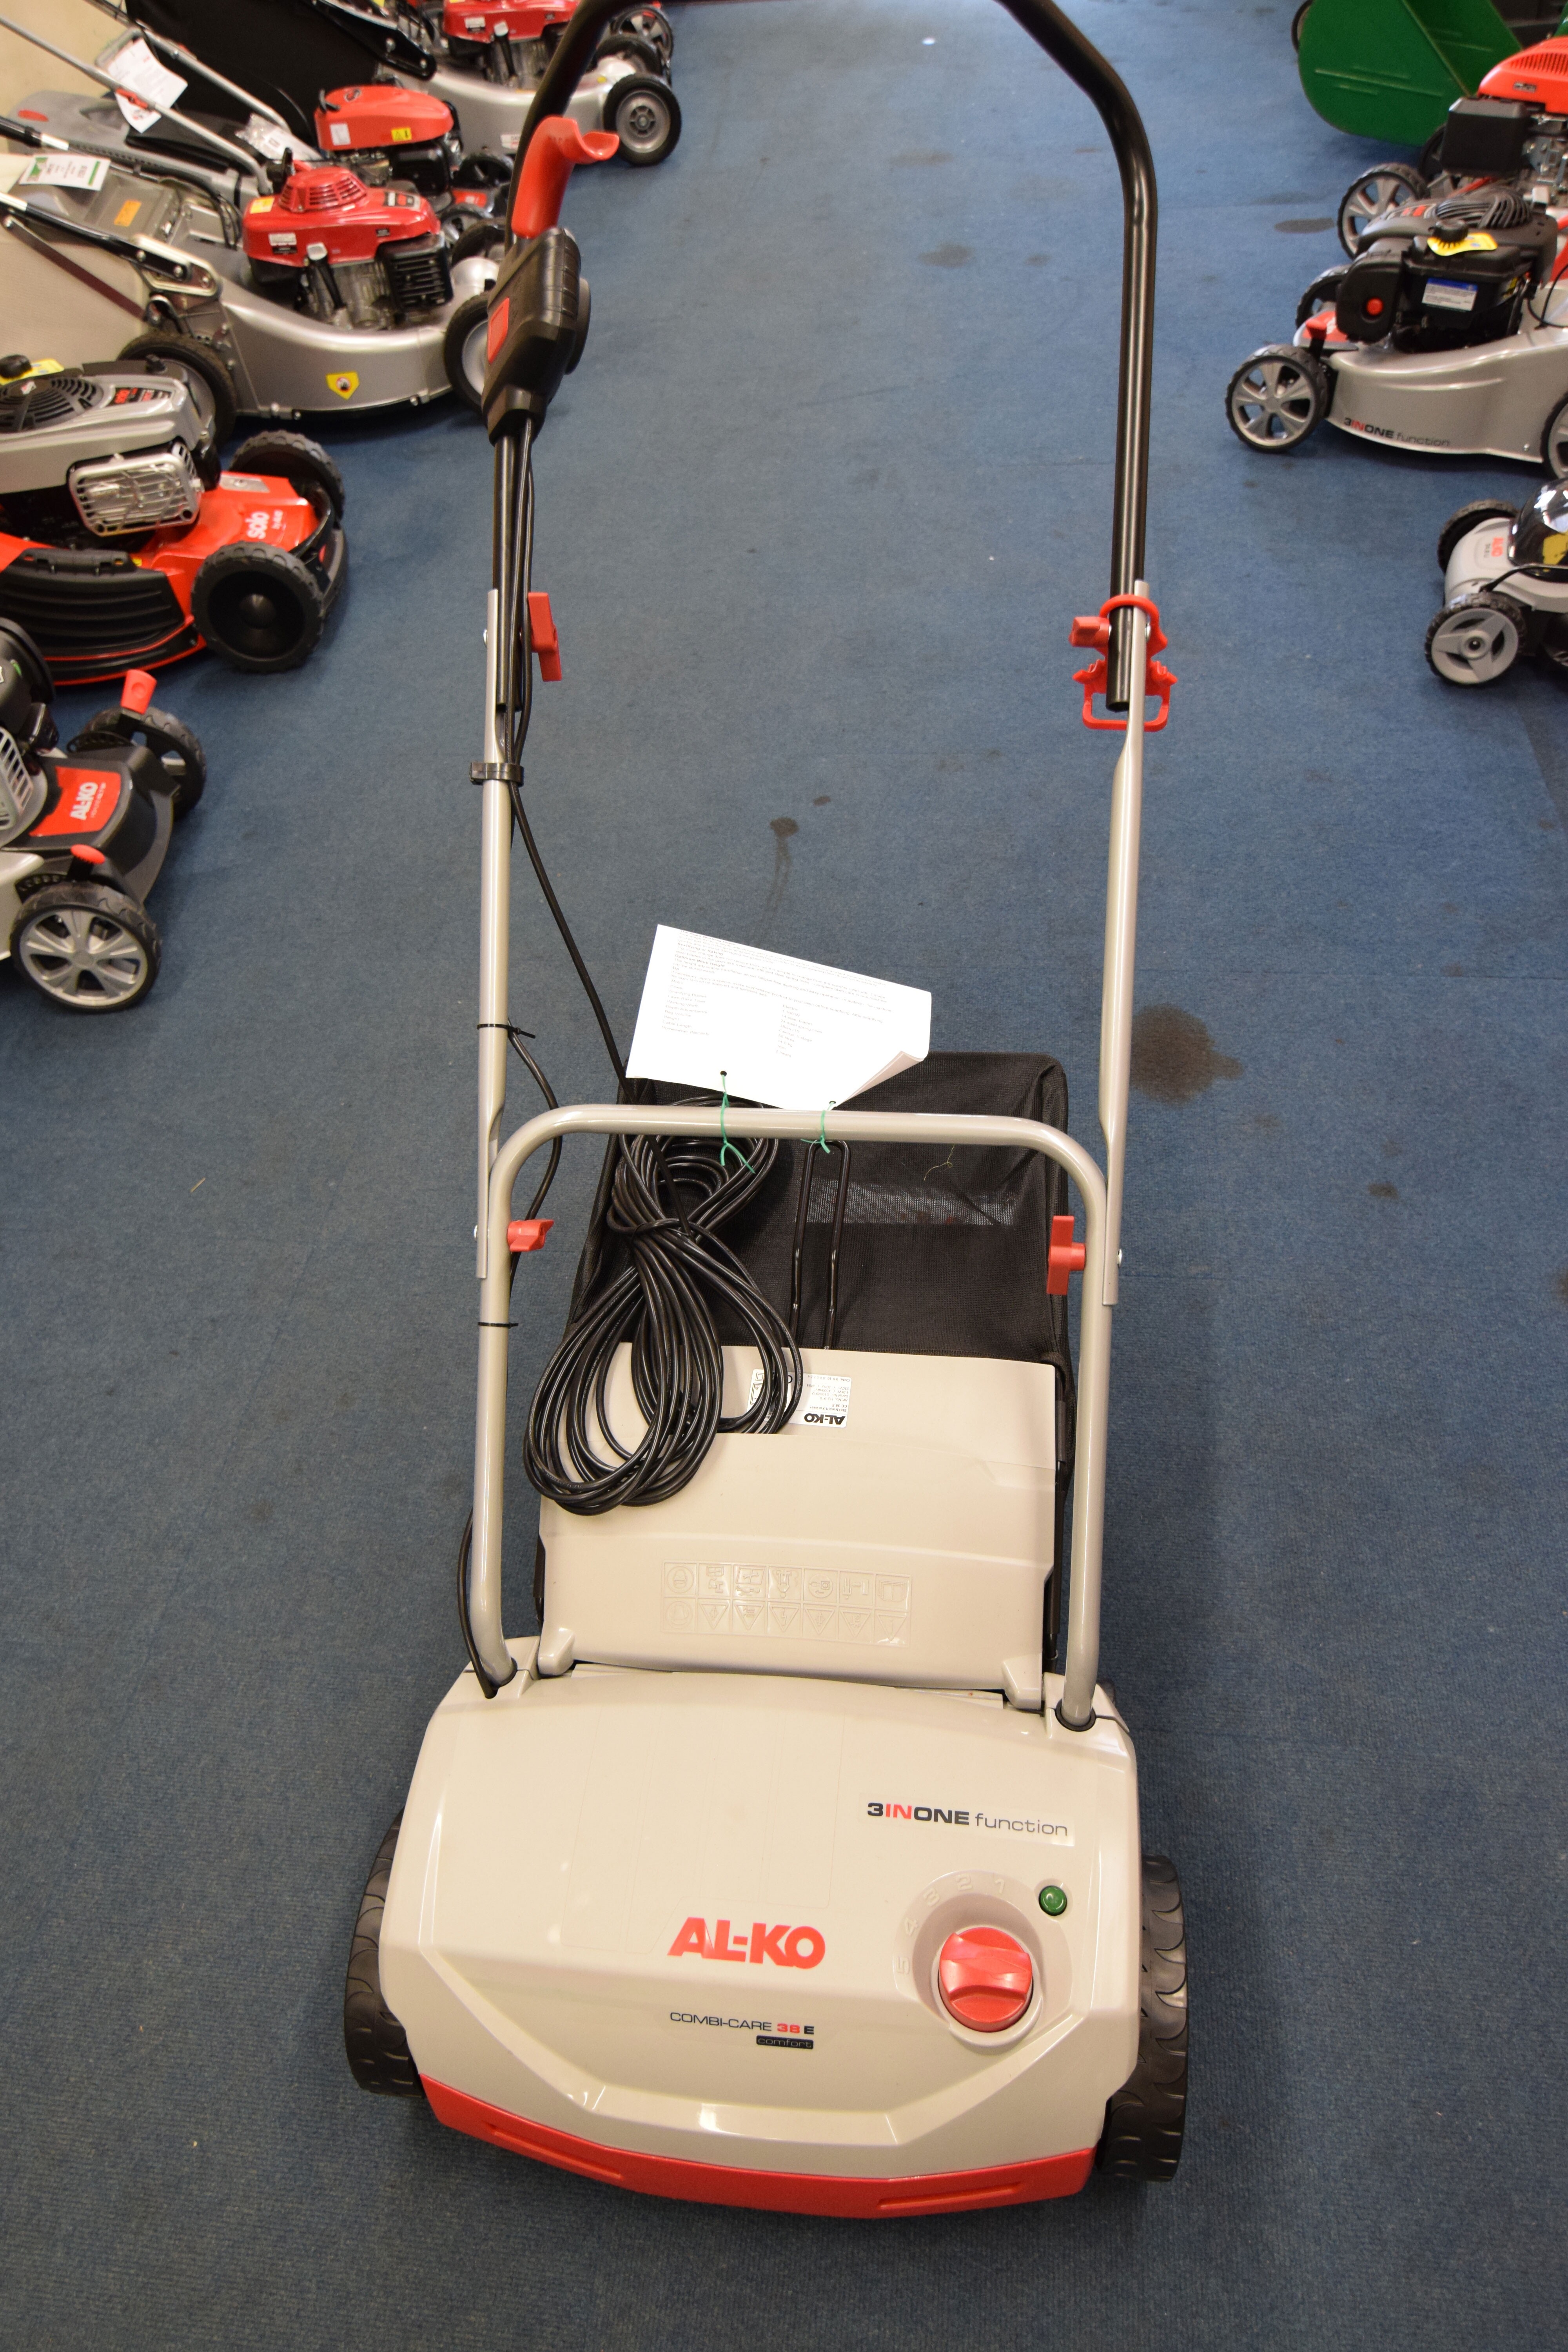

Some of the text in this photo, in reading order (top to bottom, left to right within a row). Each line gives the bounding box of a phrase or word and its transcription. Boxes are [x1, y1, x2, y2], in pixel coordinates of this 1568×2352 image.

[1344, 417, 1450, 446] 3INONE function
[245, 511, 270, 540] solo
[70, 782, 98, 820] AL-KO
[804, 1413, 846, 1425] AL-KO
[867, 1802, 1067, 1836] 3INONE function
[956, 1874, 973, 1891] 2
[995, 1879, 1005, 1895] 1
[923, 1887, 941, 1907] 3
[905, 1917, 919, 1936] 4
[667, 1916, 826, 1969] AL-KO
[896, 1956, 910, 1975] 5
[670, 2012, 815, 2034] COMBI-CARE 38 E
[758, 2038, 811, 2048] comfort
